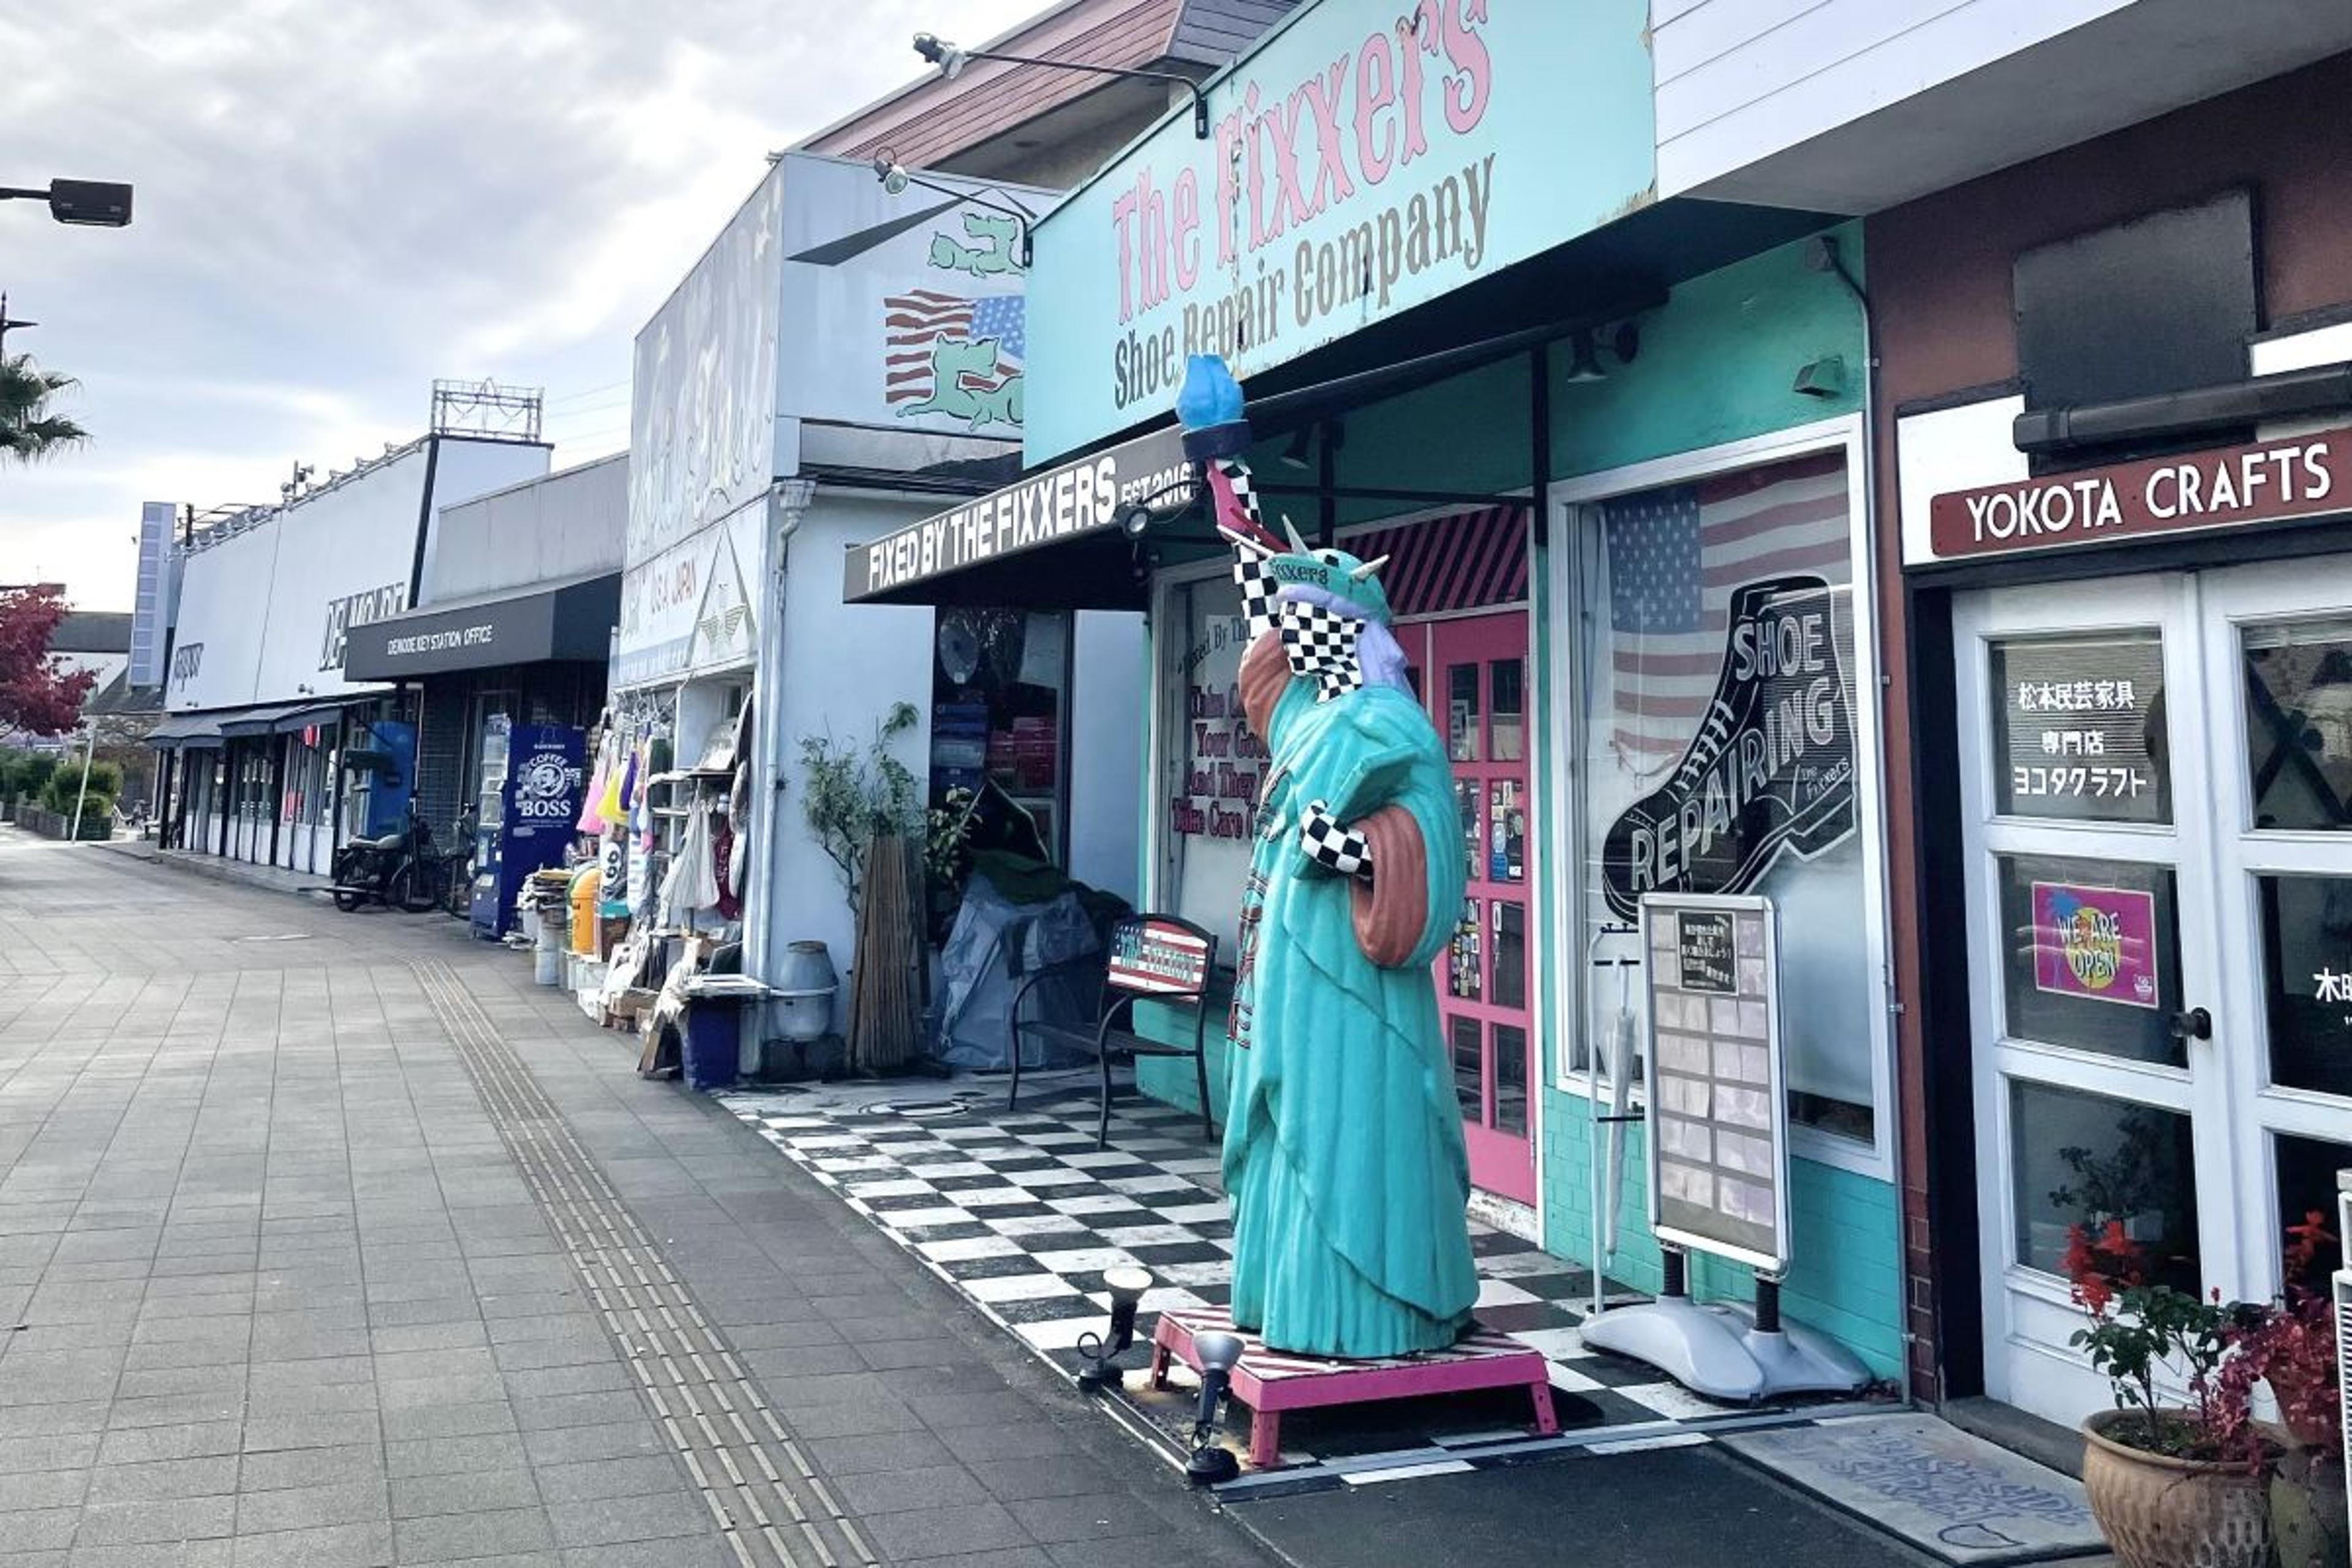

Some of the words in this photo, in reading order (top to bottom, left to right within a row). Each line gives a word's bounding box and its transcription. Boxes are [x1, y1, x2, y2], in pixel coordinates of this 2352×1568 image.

[1113, 165, 1201, 325] The
[1215, 0, 1491, 270] Fixxers
[1114, 328, 1175, 410] Shoe
[1183, 256, 1285, 366] Repair
[1294, 152, 1496, 327] Company
[1966, 478, 2122, 542] YOKOTA
[2145, 443, 2332, 519] CRAFTS
[868, 529, 918, 592] FIXED
[920, 518, 946, 575] BY
[949, 508, 994, 566] THE
[997, 456, 1117, 552] FIXXERS
[464, 625, 492, 646] OFFICE
[1733, 612, 1825, 682] SHOE
[2018, 680, 2135, 710] 松本民芸家具
[2041, 730, 2104, 755] 専門店
[1630, 676, 1840, 891] REPAIRING
[2014, 766, 2147, 797] ヨコタクラフト
[521, 799, 571, 816] BOSS
[2057, 914, 2082, 944] WE
[2090, 911, 2122, 942] ARE
[2073, 949, 2116, 978] OPEN
